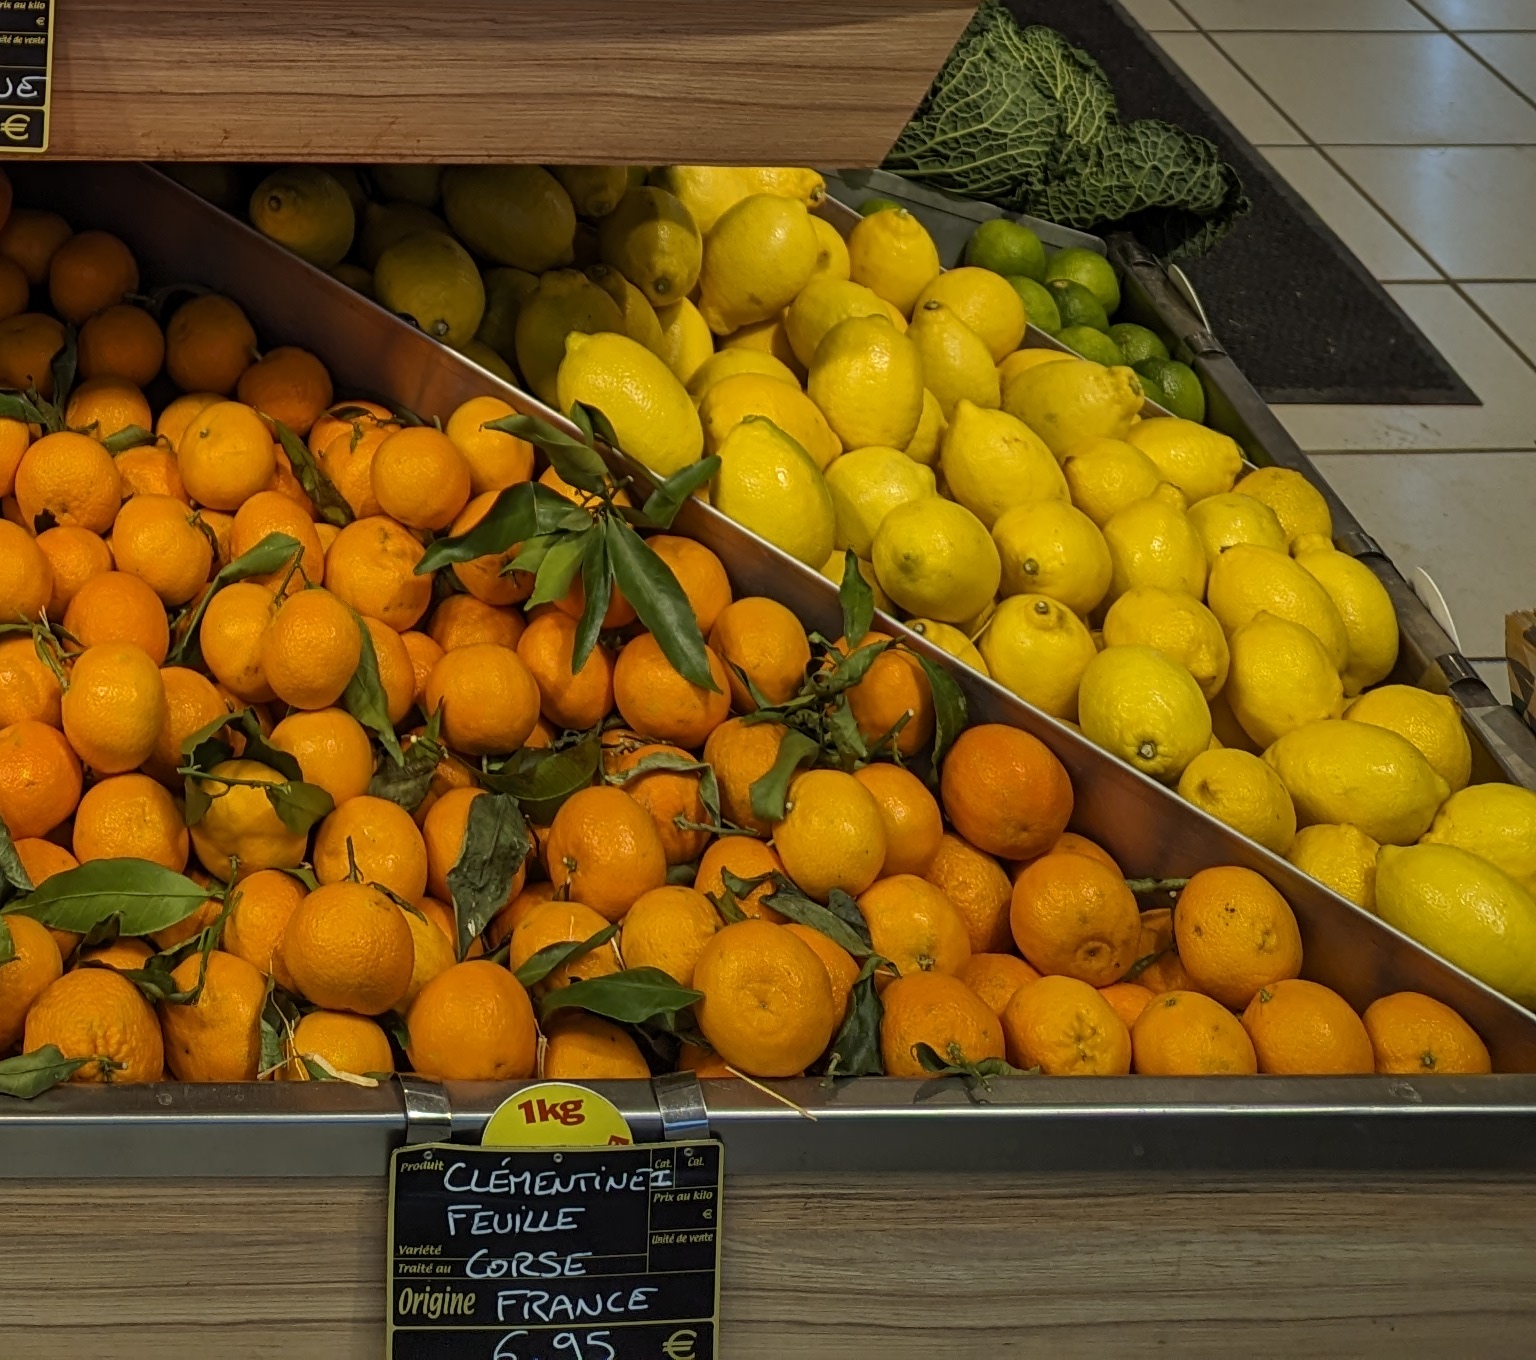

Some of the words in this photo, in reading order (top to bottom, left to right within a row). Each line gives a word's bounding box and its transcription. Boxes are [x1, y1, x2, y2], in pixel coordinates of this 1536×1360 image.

[0, 113, 31, 141] €
[517, 1098, 586, 1127] 1kg
[400, 1159, 445, 1173] Produit
[653, 1191, 674, 1203] Prix
[676, 1191, 691, 1202] au
[692, 1189, 713, 1202] kilo
[447, 1204, 586, 1236] FEUILLE
[398, 1244, 443, 1257] Variété
[652, 1232, 675, 1245] Unité
[676, 1233, 688, 1244] de
[689, 1231, 714, 1243] vente
[398, 1262, 434, 1275] Traité
[435, 1264, 452, 1275] au
[464, 1249, 593, 1280] CORSE
[398, 1286, 476, 1320] Origine
[497, 1288, 660, 1322] FRANCE
[662, 1329, 698, 1360] €
